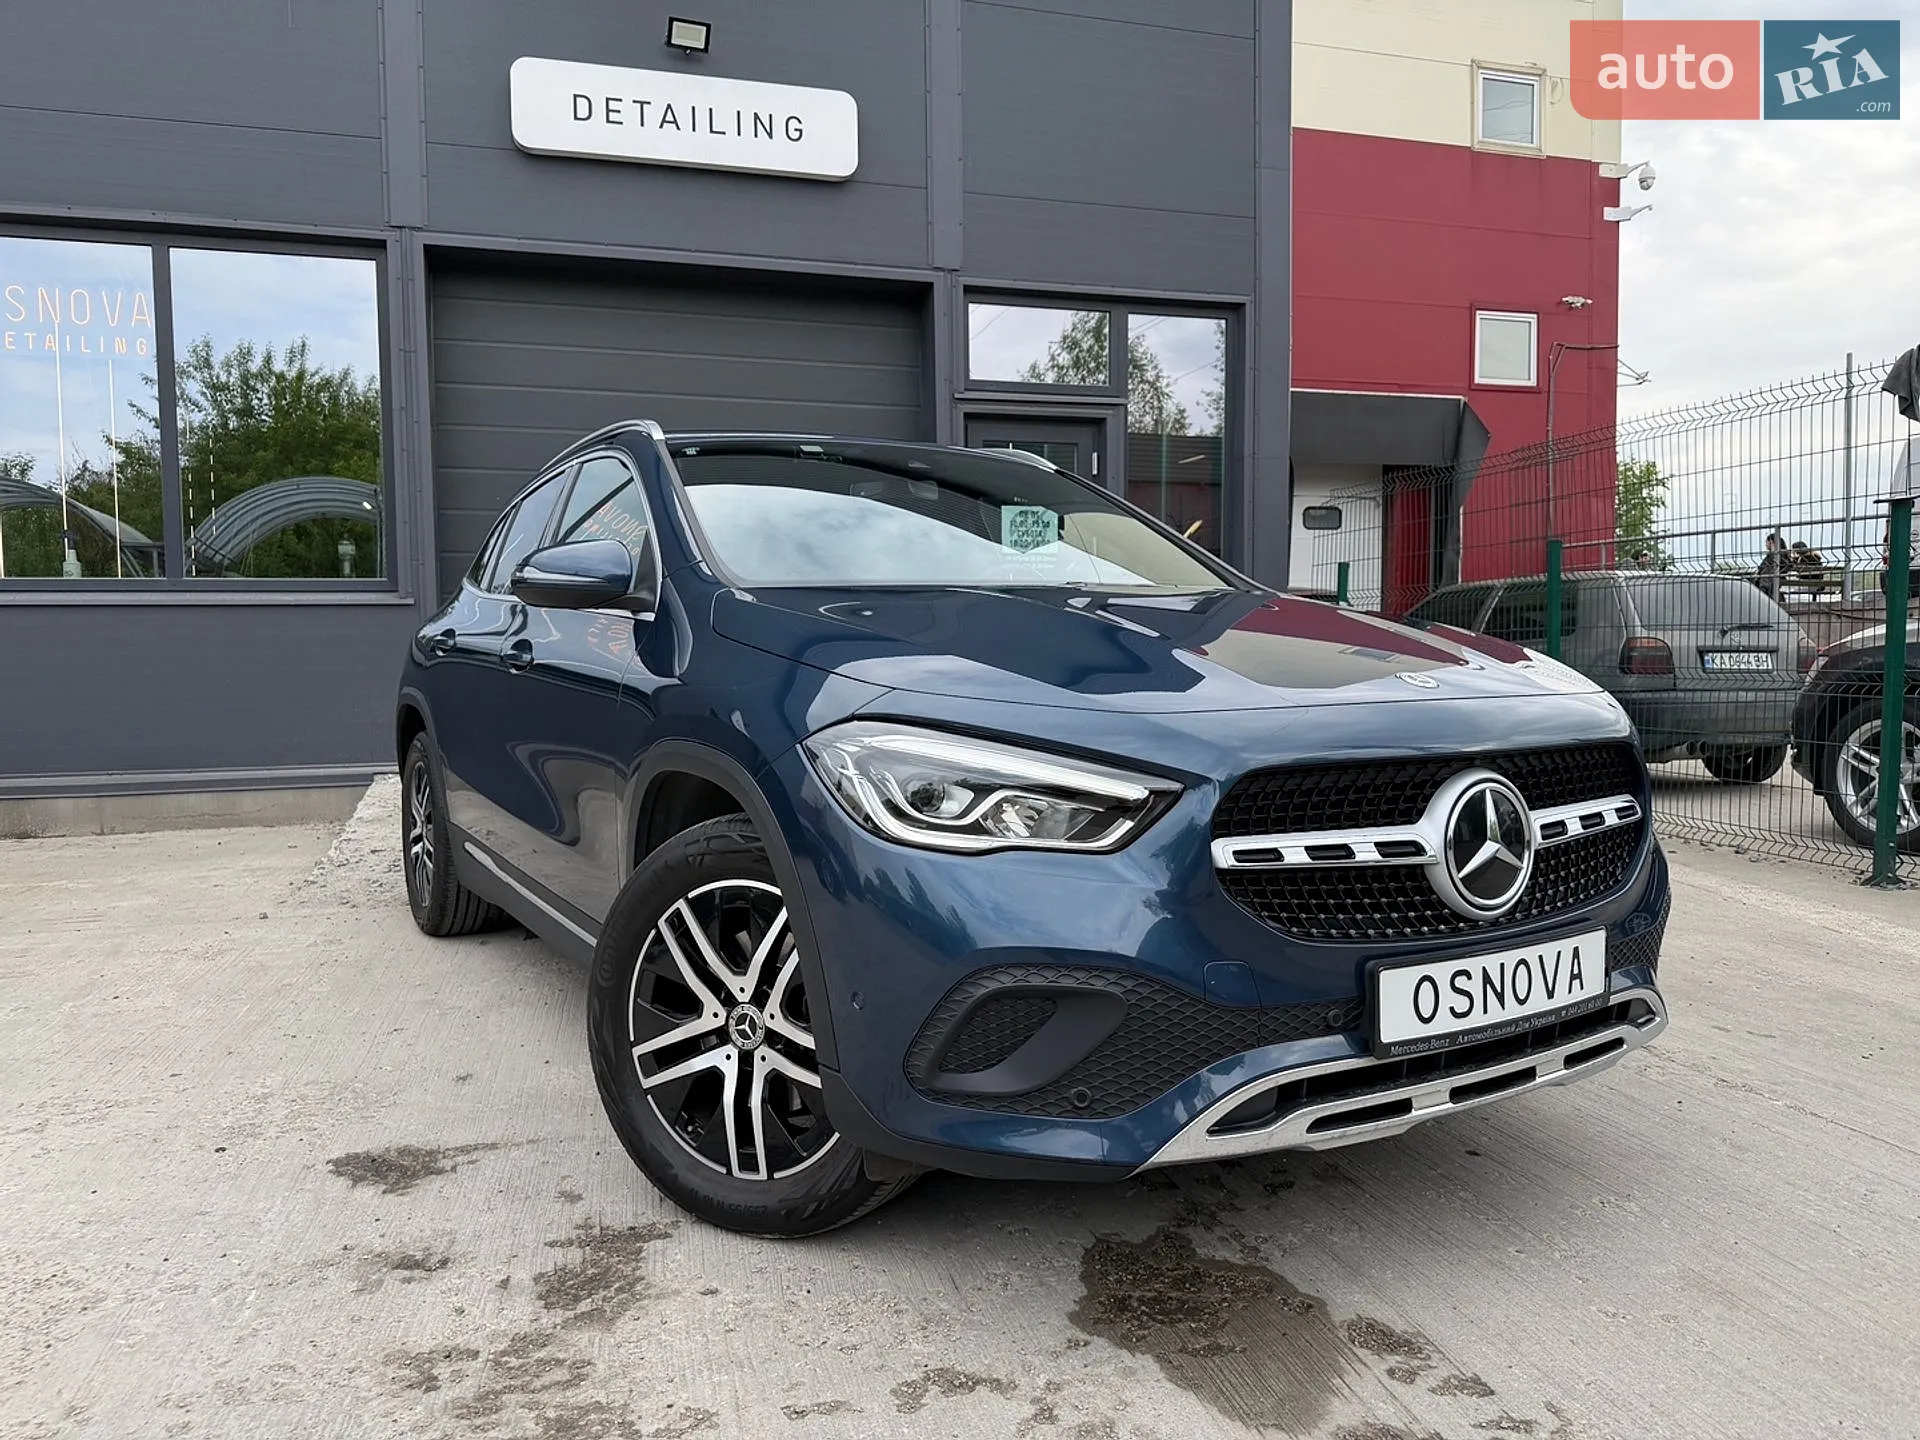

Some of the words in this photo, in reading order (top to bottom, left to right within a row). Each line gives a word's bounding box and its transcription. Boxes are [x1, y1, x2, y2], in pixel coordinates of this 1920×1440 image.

[572, 92, 805, 143] DETAILING
[4, 284, 153, 329] SNOVA
[4, 331, 149, 356] ETAILING
[1412, 945, 1585, 1025] OSNOVA
